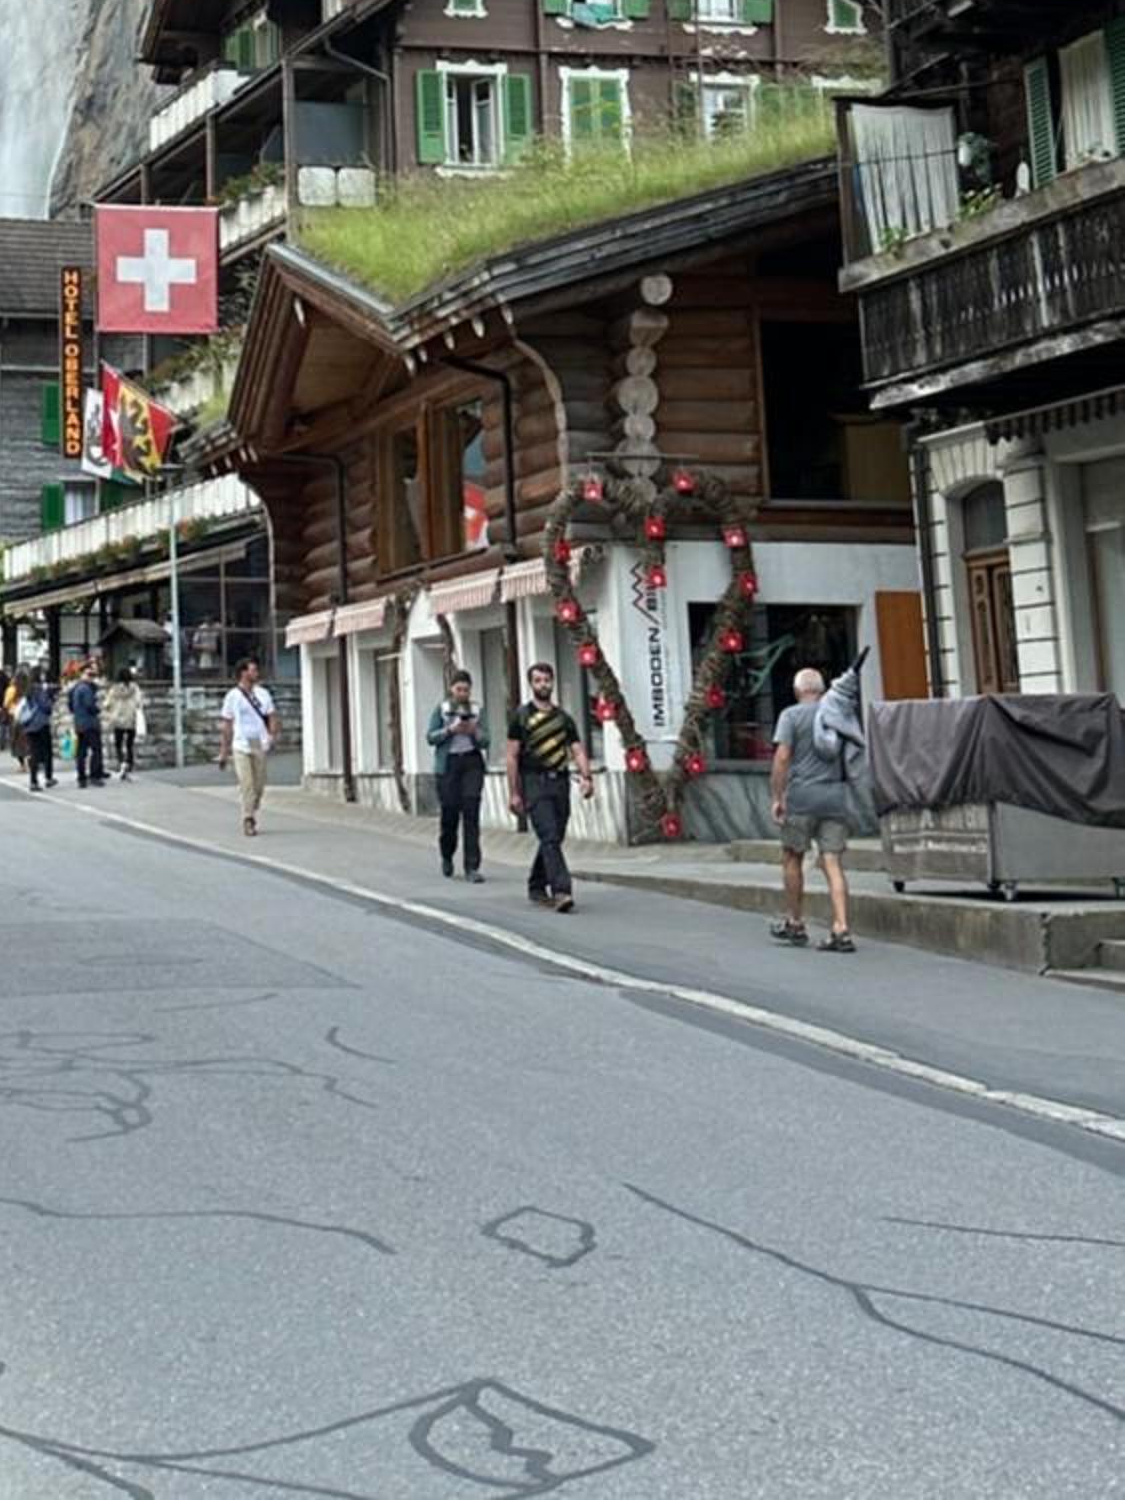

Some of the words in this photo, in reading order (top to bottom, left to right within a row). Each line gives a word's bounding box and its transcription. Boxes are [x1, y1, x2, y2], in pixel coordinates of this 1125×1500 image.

[63, 270, 79, 339] HOTEL
[64, 346, 81, 455] OBERLAND
[648, 626, 665, 728] IMBODEN
